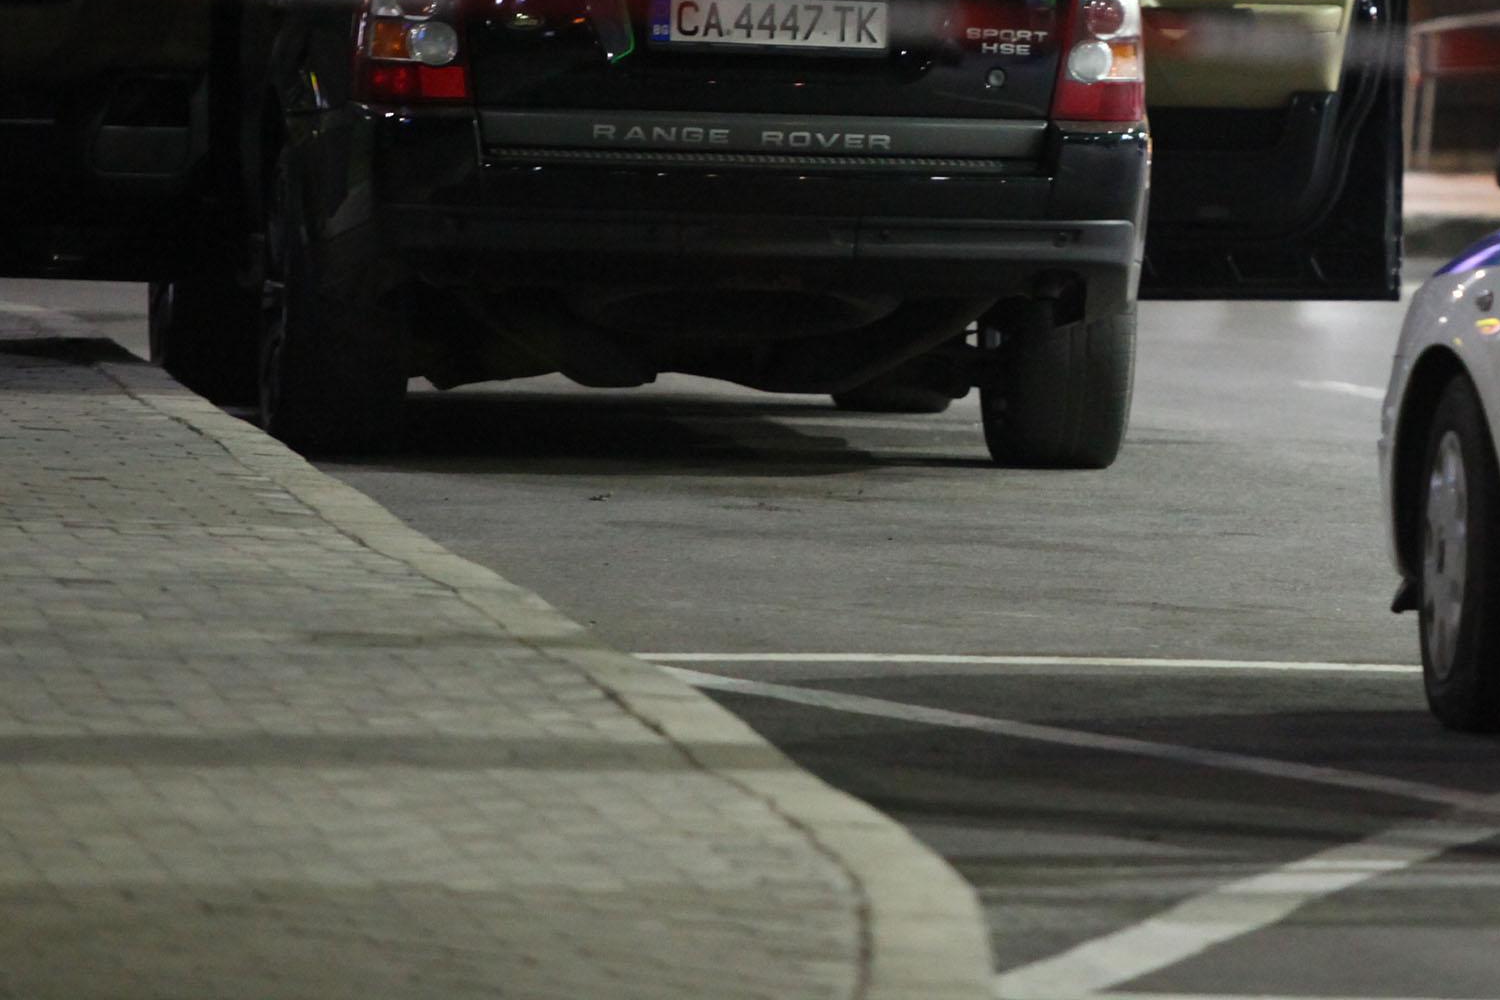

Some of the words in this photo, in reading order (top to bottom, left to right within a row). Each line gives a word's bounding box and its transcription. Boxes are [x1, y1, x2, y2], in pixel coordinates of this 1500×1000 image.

[966, 27, 1048, 42] SPORT
[981, 43, 1031, 55] HSE
[593, 124, 730, 144] RANGE
[761, 131, 891, 149] ROVER
